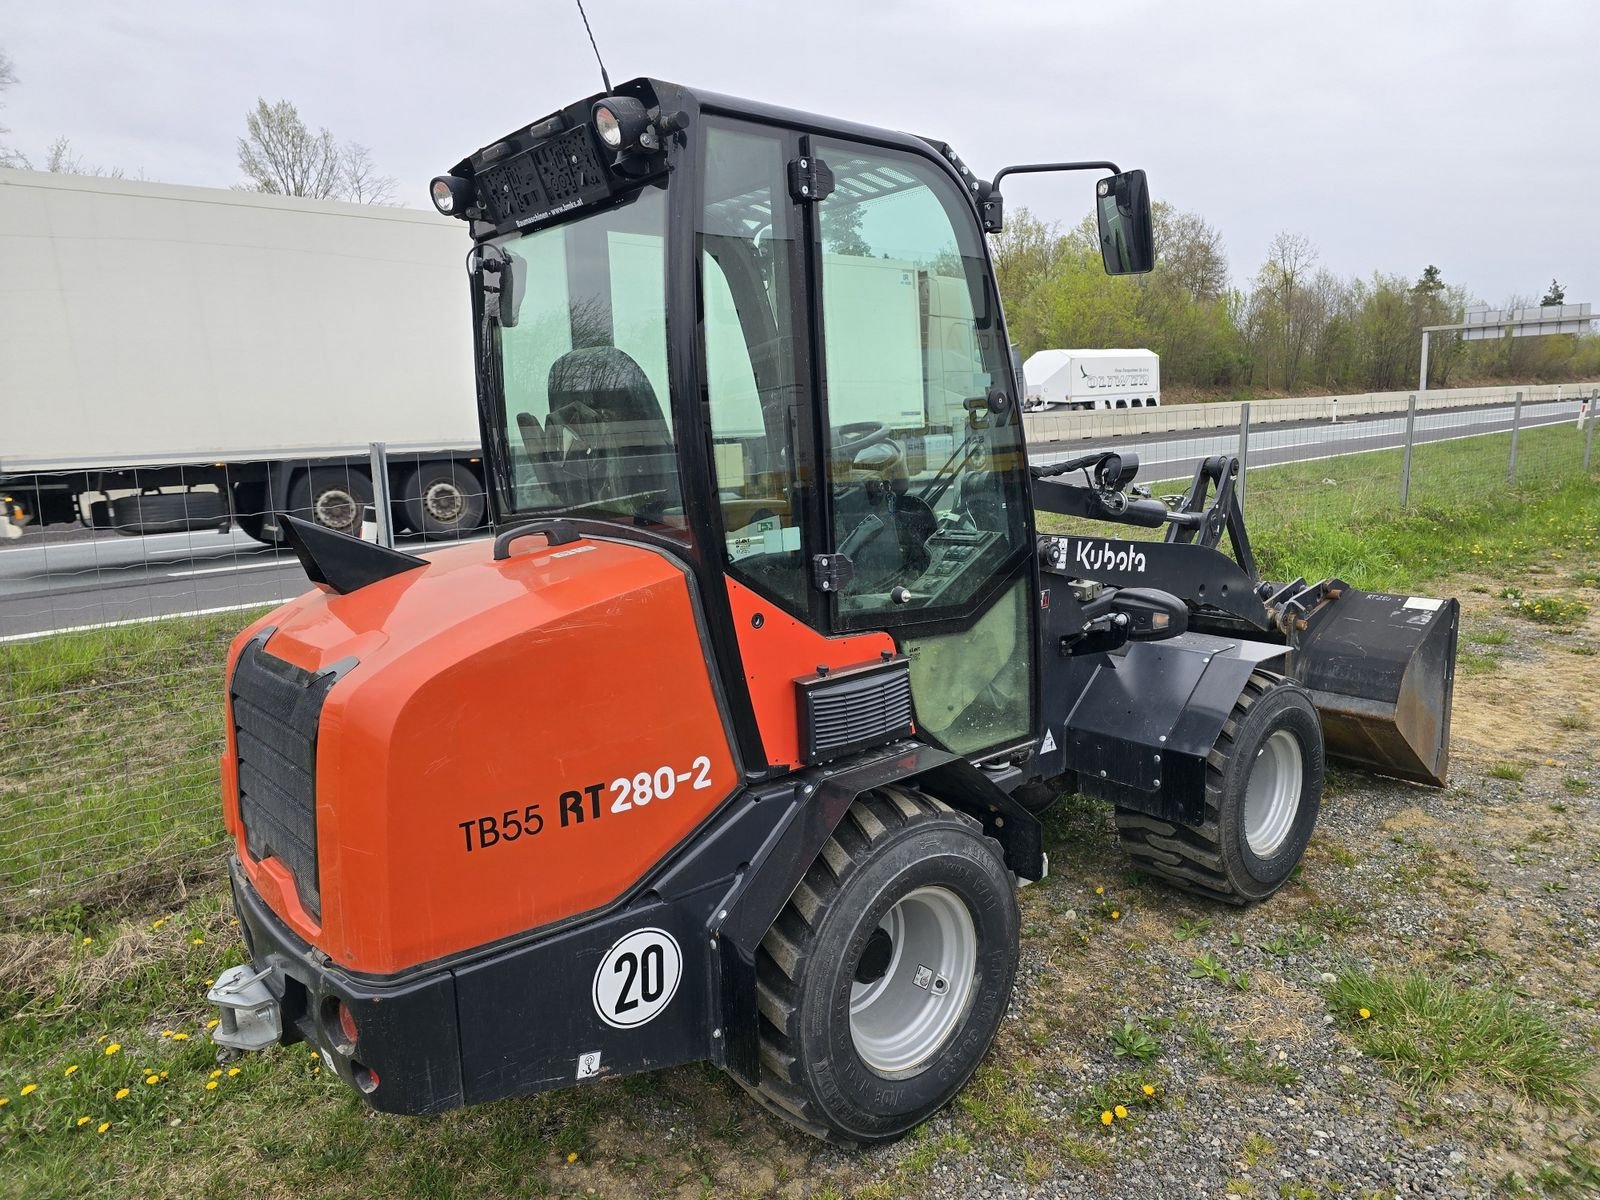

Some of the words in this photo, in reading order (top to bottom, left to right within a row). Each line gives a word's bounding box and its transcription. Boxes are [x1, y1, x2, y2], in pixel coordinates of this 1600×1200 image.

[1076, 541, 1146, 572] Kubota
[458, 804, 544, 852] TB55
[614, 944, 665, 1015] 20
